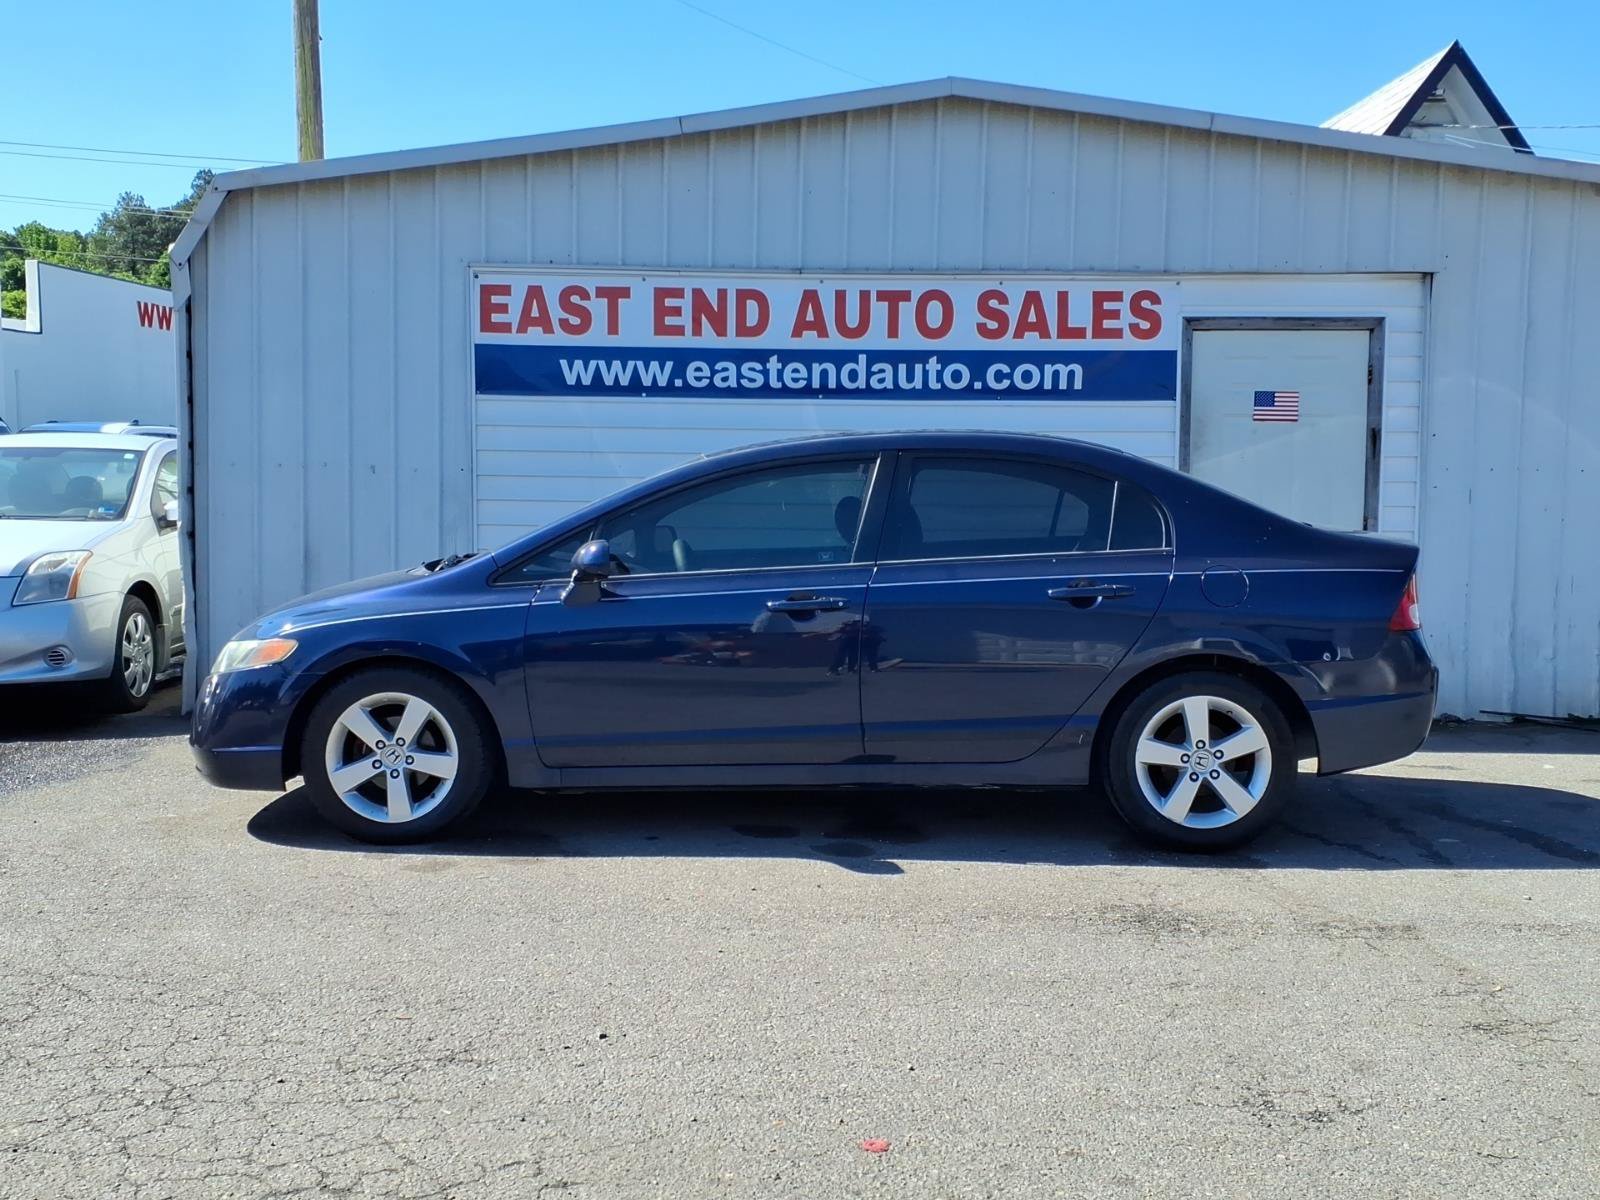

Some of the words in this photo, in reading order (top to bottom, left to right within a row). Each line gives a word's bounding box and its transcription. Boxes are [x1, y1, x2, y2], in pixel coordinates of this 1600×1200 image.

[479, 284, 631, 336] EAST
[653, 288, 770, 338] END
[791, 290, 955, 341] AUTO
[976, 290, 1163, 342] SALES
[559, 353, 1084, 391] www.eastendauto.com
